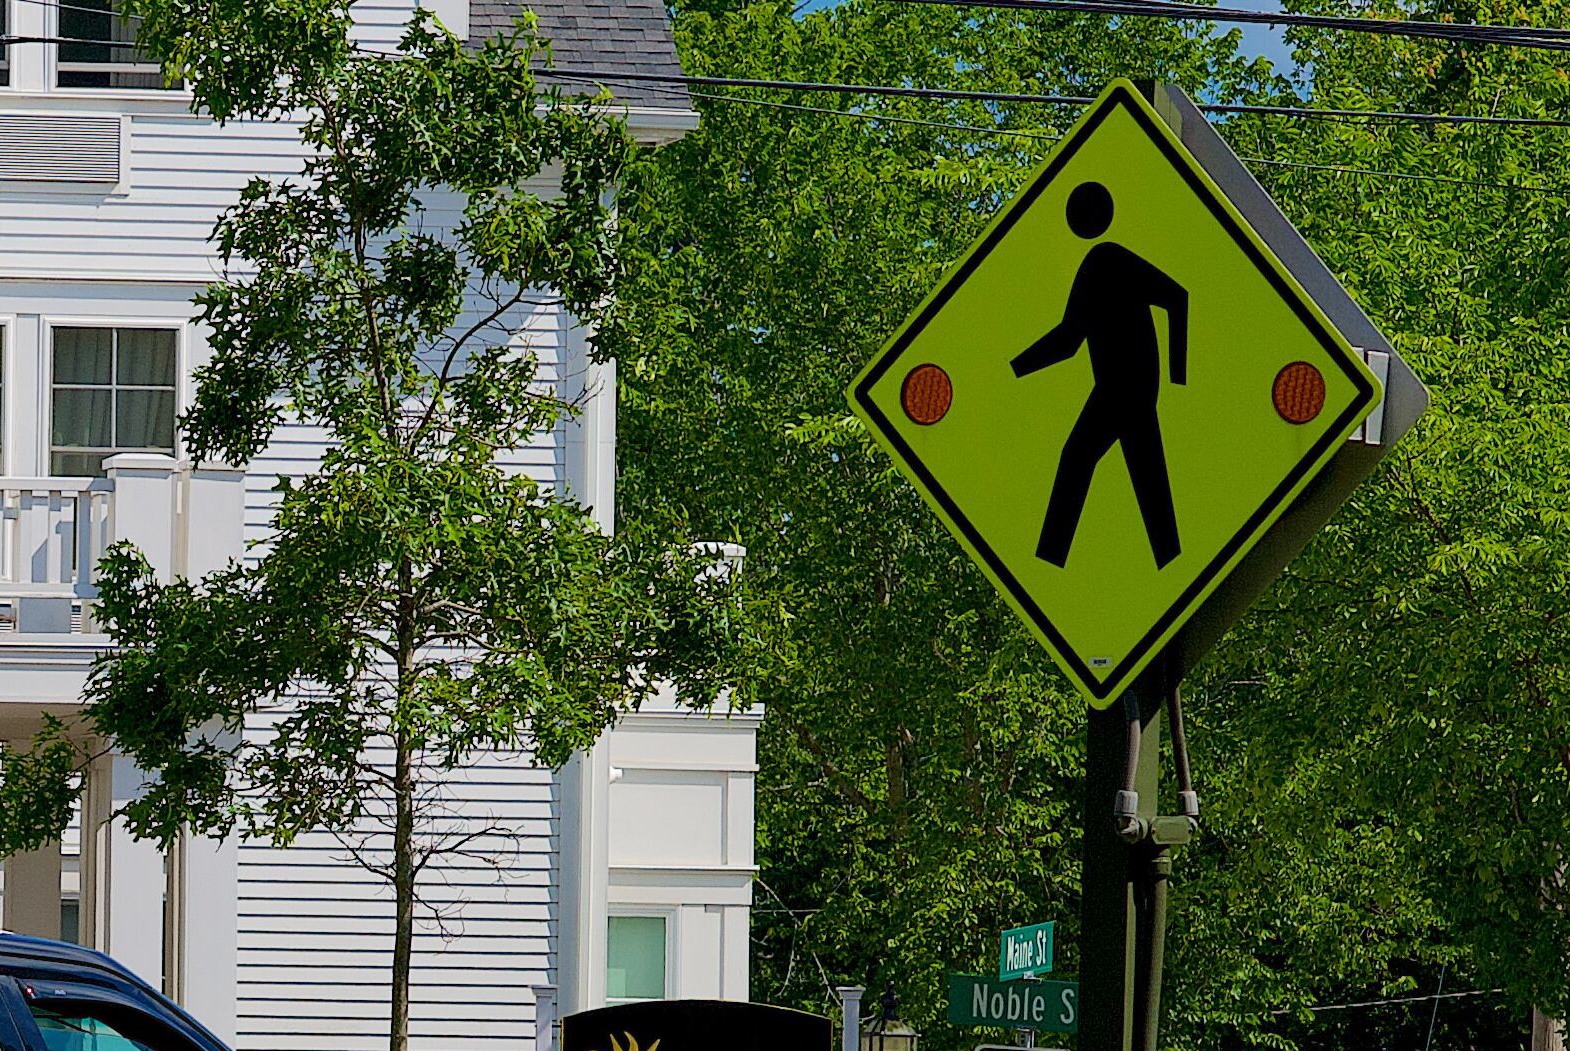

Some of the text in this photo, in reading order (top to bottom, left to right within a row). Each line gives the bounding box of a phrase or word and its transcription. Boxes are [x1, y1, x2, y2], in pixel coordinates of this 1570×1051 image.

[1006, 929, 1047, 972] Maine St
[972, 983, 1076, 1025] Noble S
